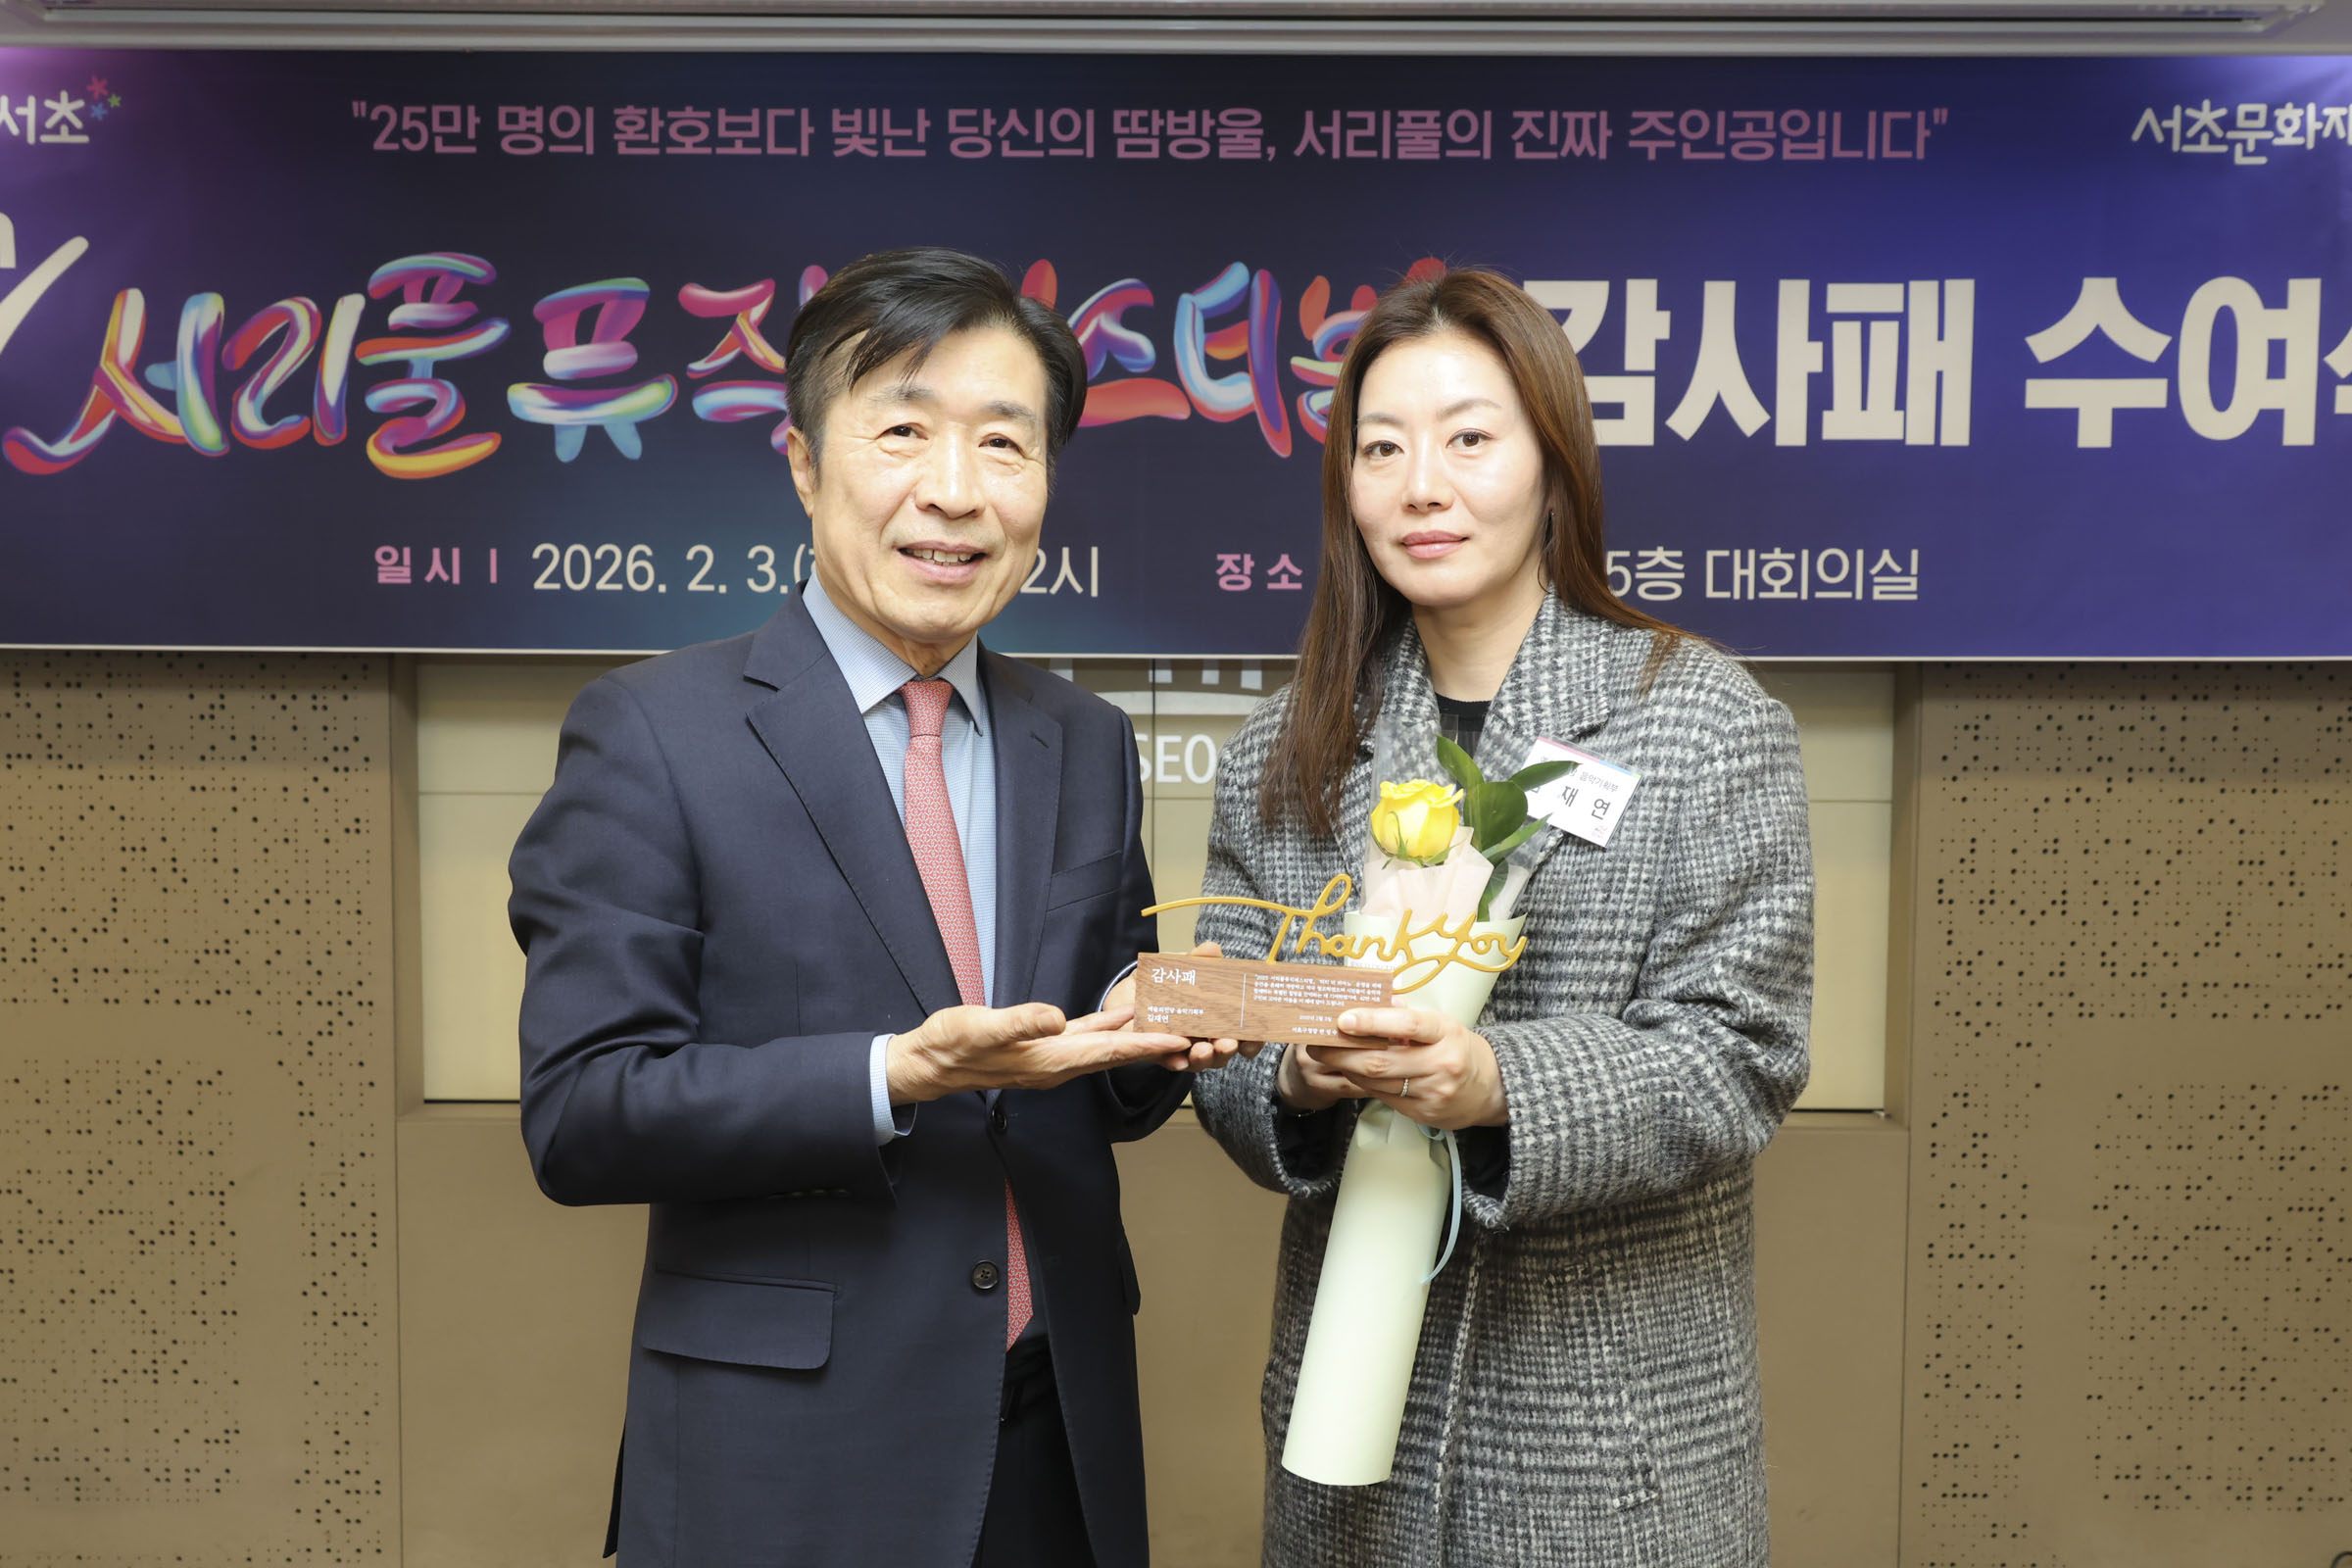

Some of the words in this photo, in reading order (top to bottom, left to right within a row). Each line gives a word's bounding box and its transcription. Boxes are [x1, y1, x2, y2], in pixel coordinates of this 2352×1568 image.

[0, 90, 90, 145] 서초
[352, 101, 480, 154] "25만
[498, 106, 595, 155] 명의
[613, 105, 813, 157] 환호보다
[832, 108, 930, 157] 빛난
[947, 109, 1094, 158] 당신의
[1113, 109, 1276, 161] 땀방울,
[1295, 109, 1493, 159] 서리풀의
[1511, 110, 1613, 159] 진짜
[1628, 108, 1948, 161] 주인공입니다"
[1524, 278, 1976, 447] 감사패
[532, 543, 666, 593] 2026.
[686, 544, 727, 594] 2.
[1704, 547, 1920, 601] 대회의실
[1152, 966, 1197, 986] 감사패
